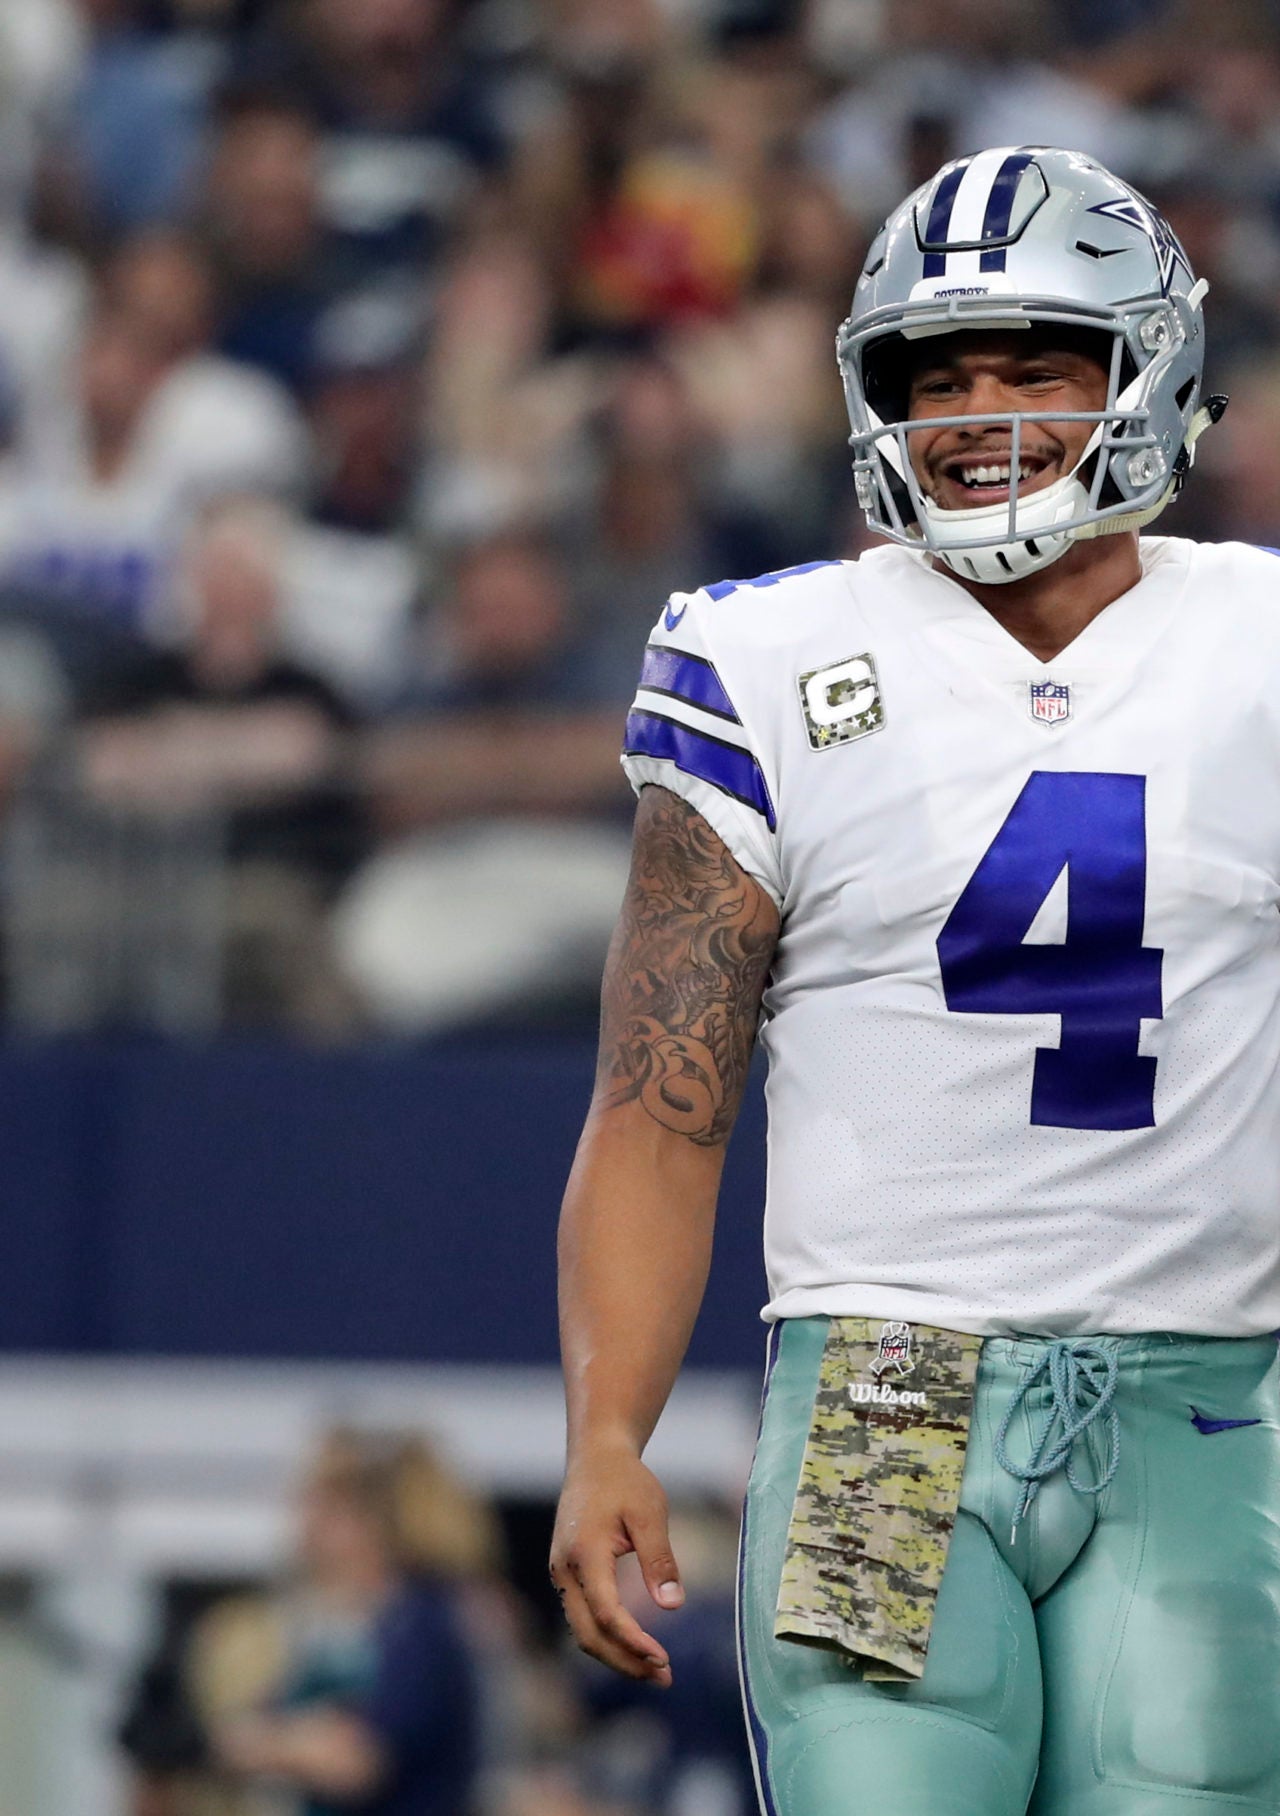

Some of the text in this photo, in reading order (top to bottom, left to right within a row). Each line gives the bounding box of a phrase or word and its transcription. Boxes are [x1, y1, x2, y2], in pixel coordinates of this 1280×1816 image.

[806, 660, 876, 725] C
[1035, 698, 1066, 719] NFL
[935, 770, 1164, 1131] 4
[882, 1346, 907, 1359] NFL
[847, 1382, 927, 1405] Wilson
